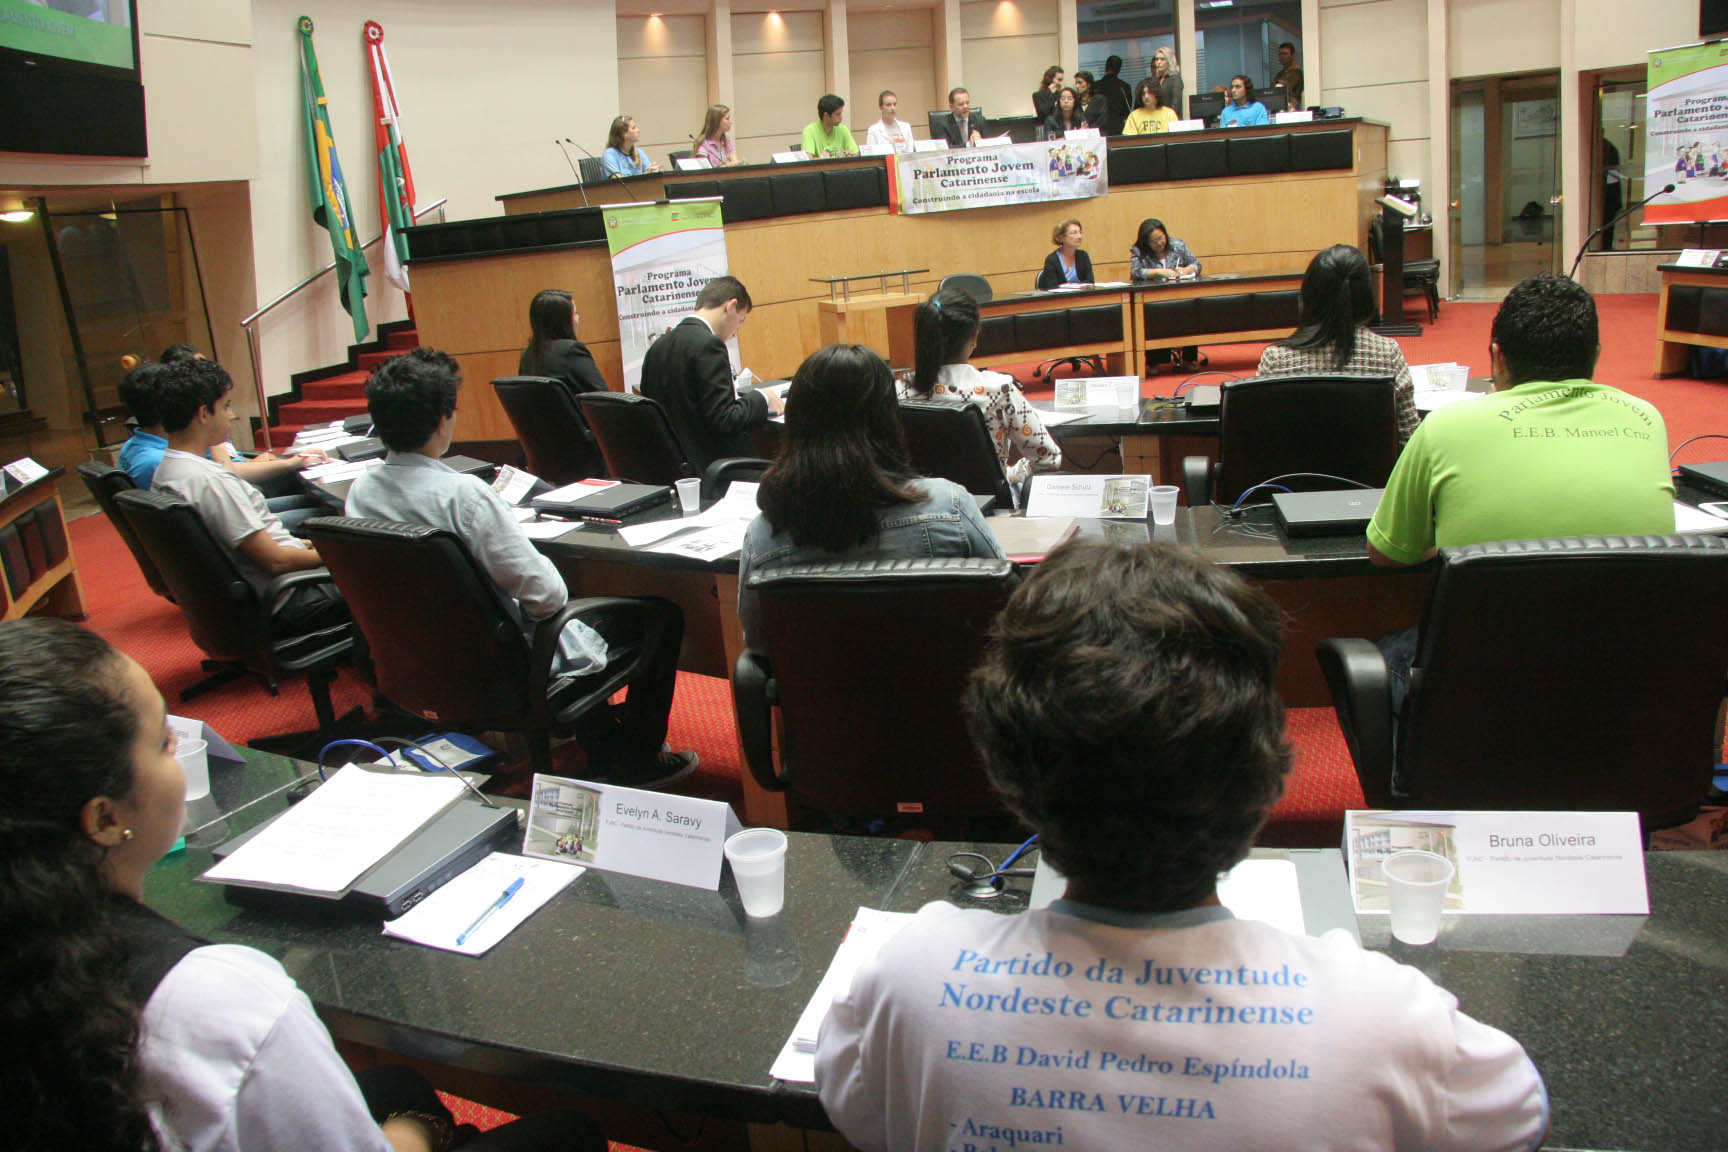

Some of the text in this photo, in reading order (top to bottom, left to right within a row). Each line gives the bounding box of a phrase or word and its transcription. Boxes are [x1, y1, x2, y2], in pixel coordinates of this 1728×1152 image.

[1653, 104, 1722, 118] Parlamento
[1677, 113, 1728, 124] Catarinen
[946, 154, 999, 167] Programa
[913, 162, 1035, 180] Parlamento Jovem
[940, 174, 1010, 188] Catarinense
[912, 193, 962, 205] Construindo
[968, 189, 1005, 200] cidadania
[1016, 186, 1041, 196] escola
[647, 268, 692, 281] Programa
[617, 279, 685, 297] Parlamento
[642, 289, 701, 304] Catarinense
[618, 310, 661, 321] Construindo
[1499, 387, 1653, 427] Parlamento Jovem
[1565, 427, 1620, 439] Manoel
[616, 803, 650, 821] Evelyn
[651, 809, 661, 821] A.
[665, 811, 703, 831] Saravy
[1489, 832, 1597, 848] Bruna Oliveira
[951, 948, 1310, 989] Partido da Juventude
[937, 981, 1314, 1026] Nordeste Catarinense
[944, 1039, 1311, 1085] E.E.B David Pedro Espíndola
[1008, 1086, 1218, 1121] BARRA VELHA
[962, 1117, 1065, 1148] Araquari
